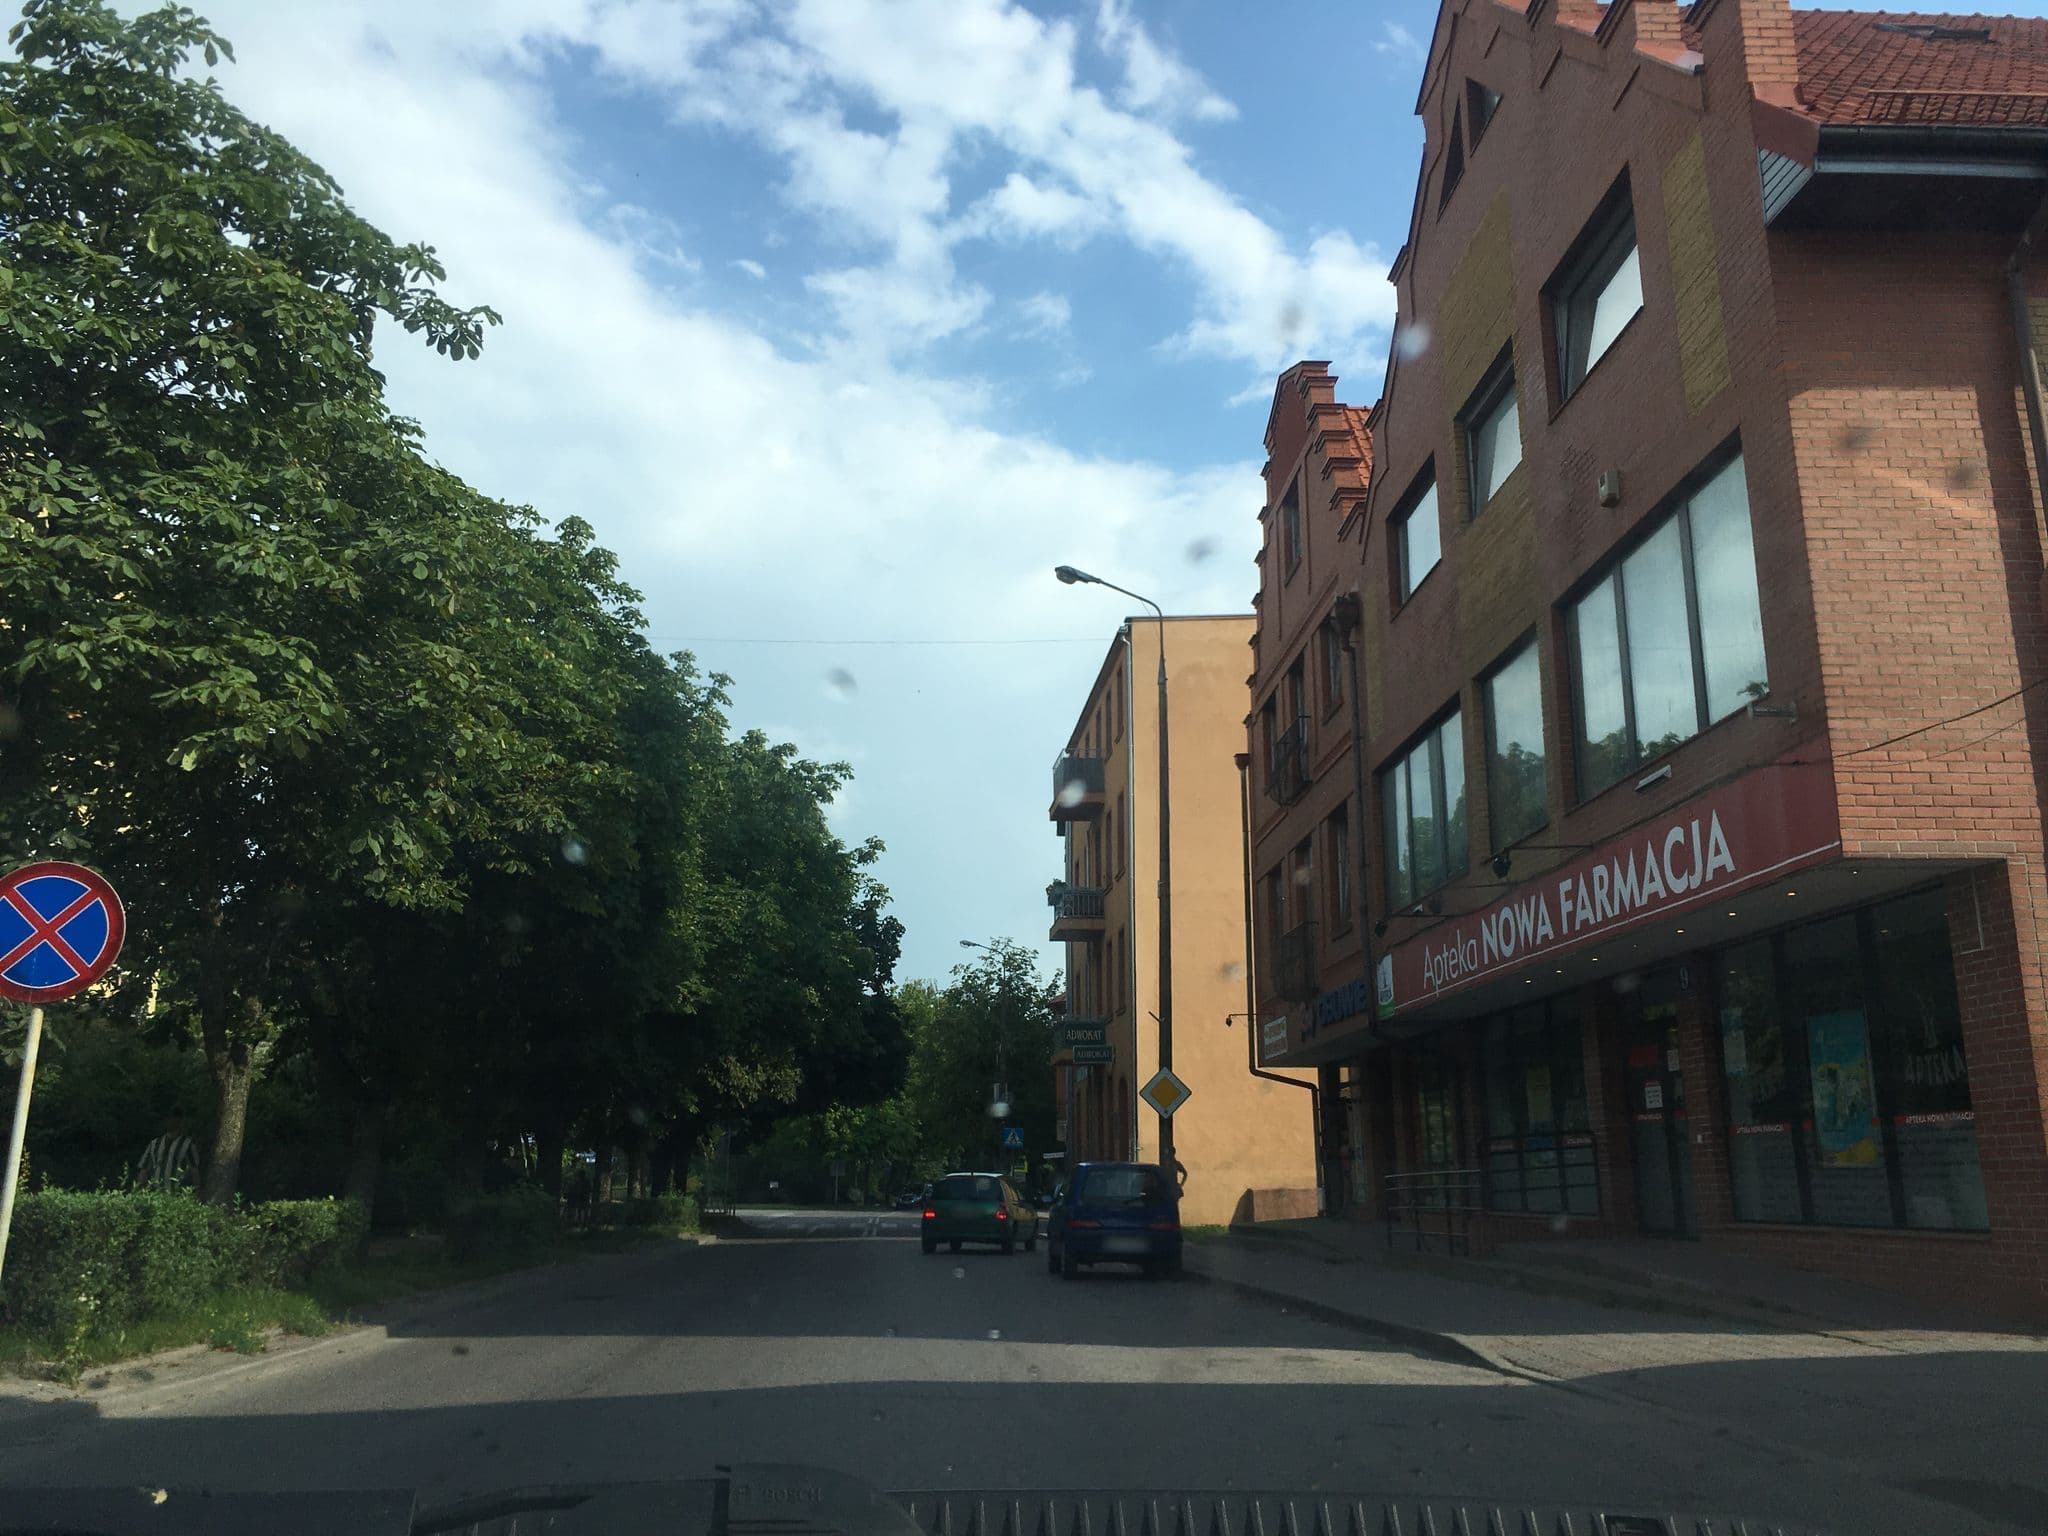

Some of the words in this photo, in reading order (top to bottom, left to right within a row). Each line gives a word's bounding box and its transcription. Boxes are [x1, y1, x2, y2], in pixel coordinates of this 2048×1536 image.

[1423, 929, 1478, 997] Apteka
[1481, 896, 1554, 965] NOWA
[1559, 809, 1736, 935] FARMACJA
[1066, 1029, 1103, 1041] ADWOKAT
[1904, 1044, 1966, 1087] APTEKA
